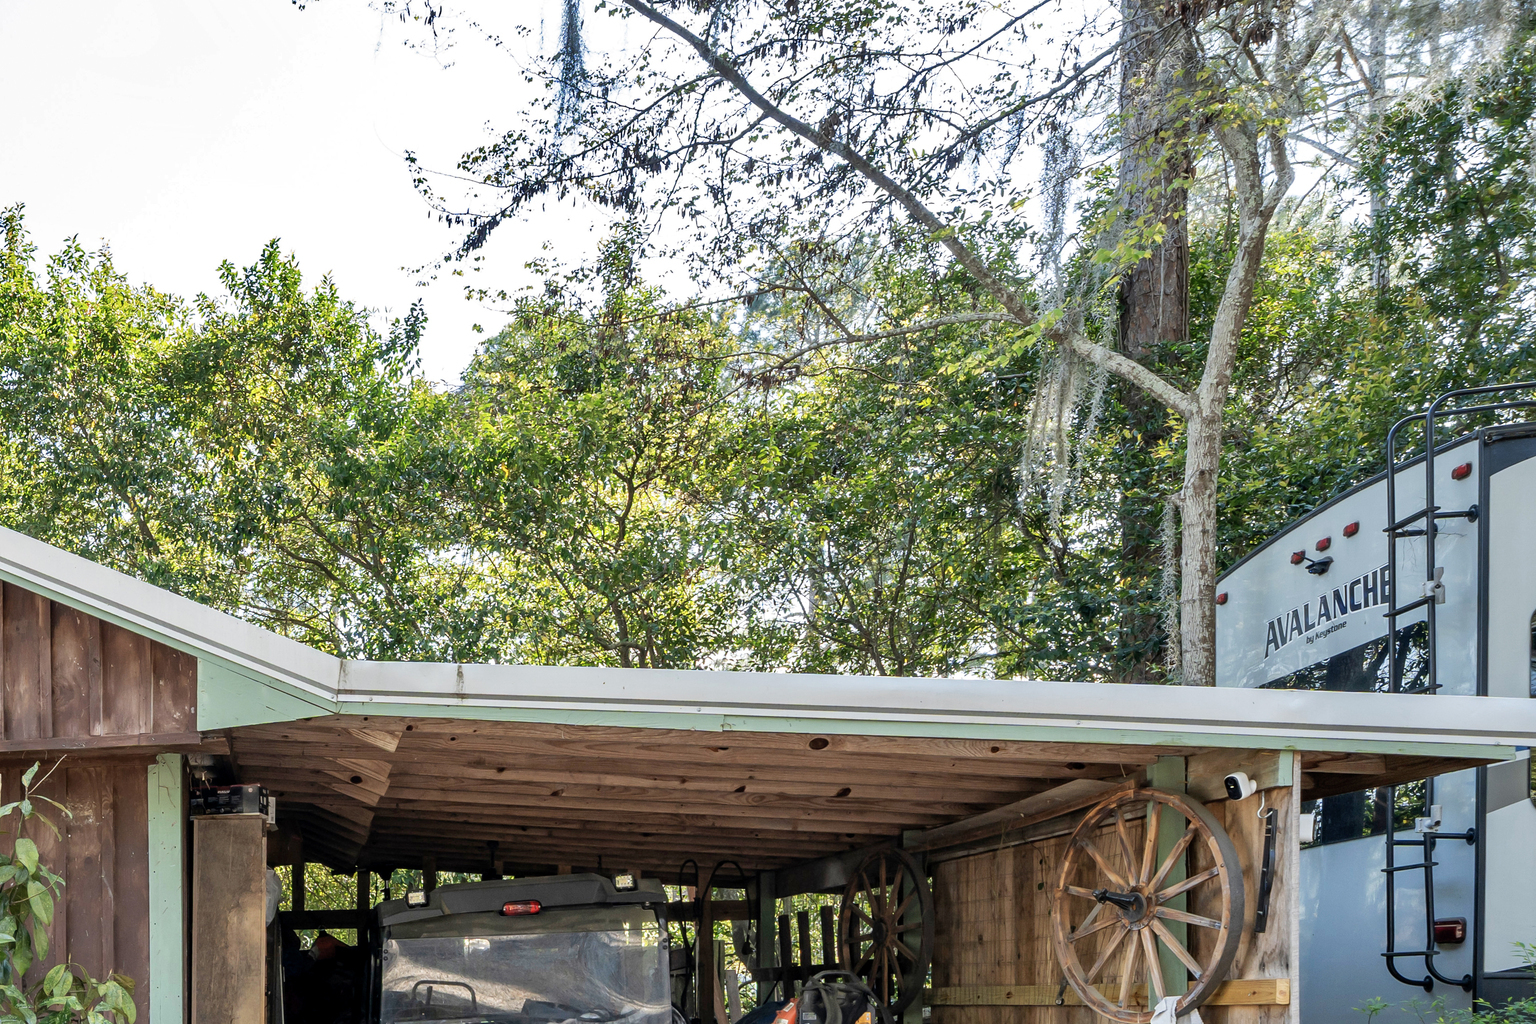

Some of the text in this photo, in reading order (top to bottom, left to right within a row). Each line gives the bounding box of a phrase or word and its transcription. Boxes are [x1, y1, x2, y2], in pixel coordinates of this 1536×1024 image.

[1264, 563, 1389, 660] AVALANCHE
[1306, 620, 1347, 644] by Keystone
